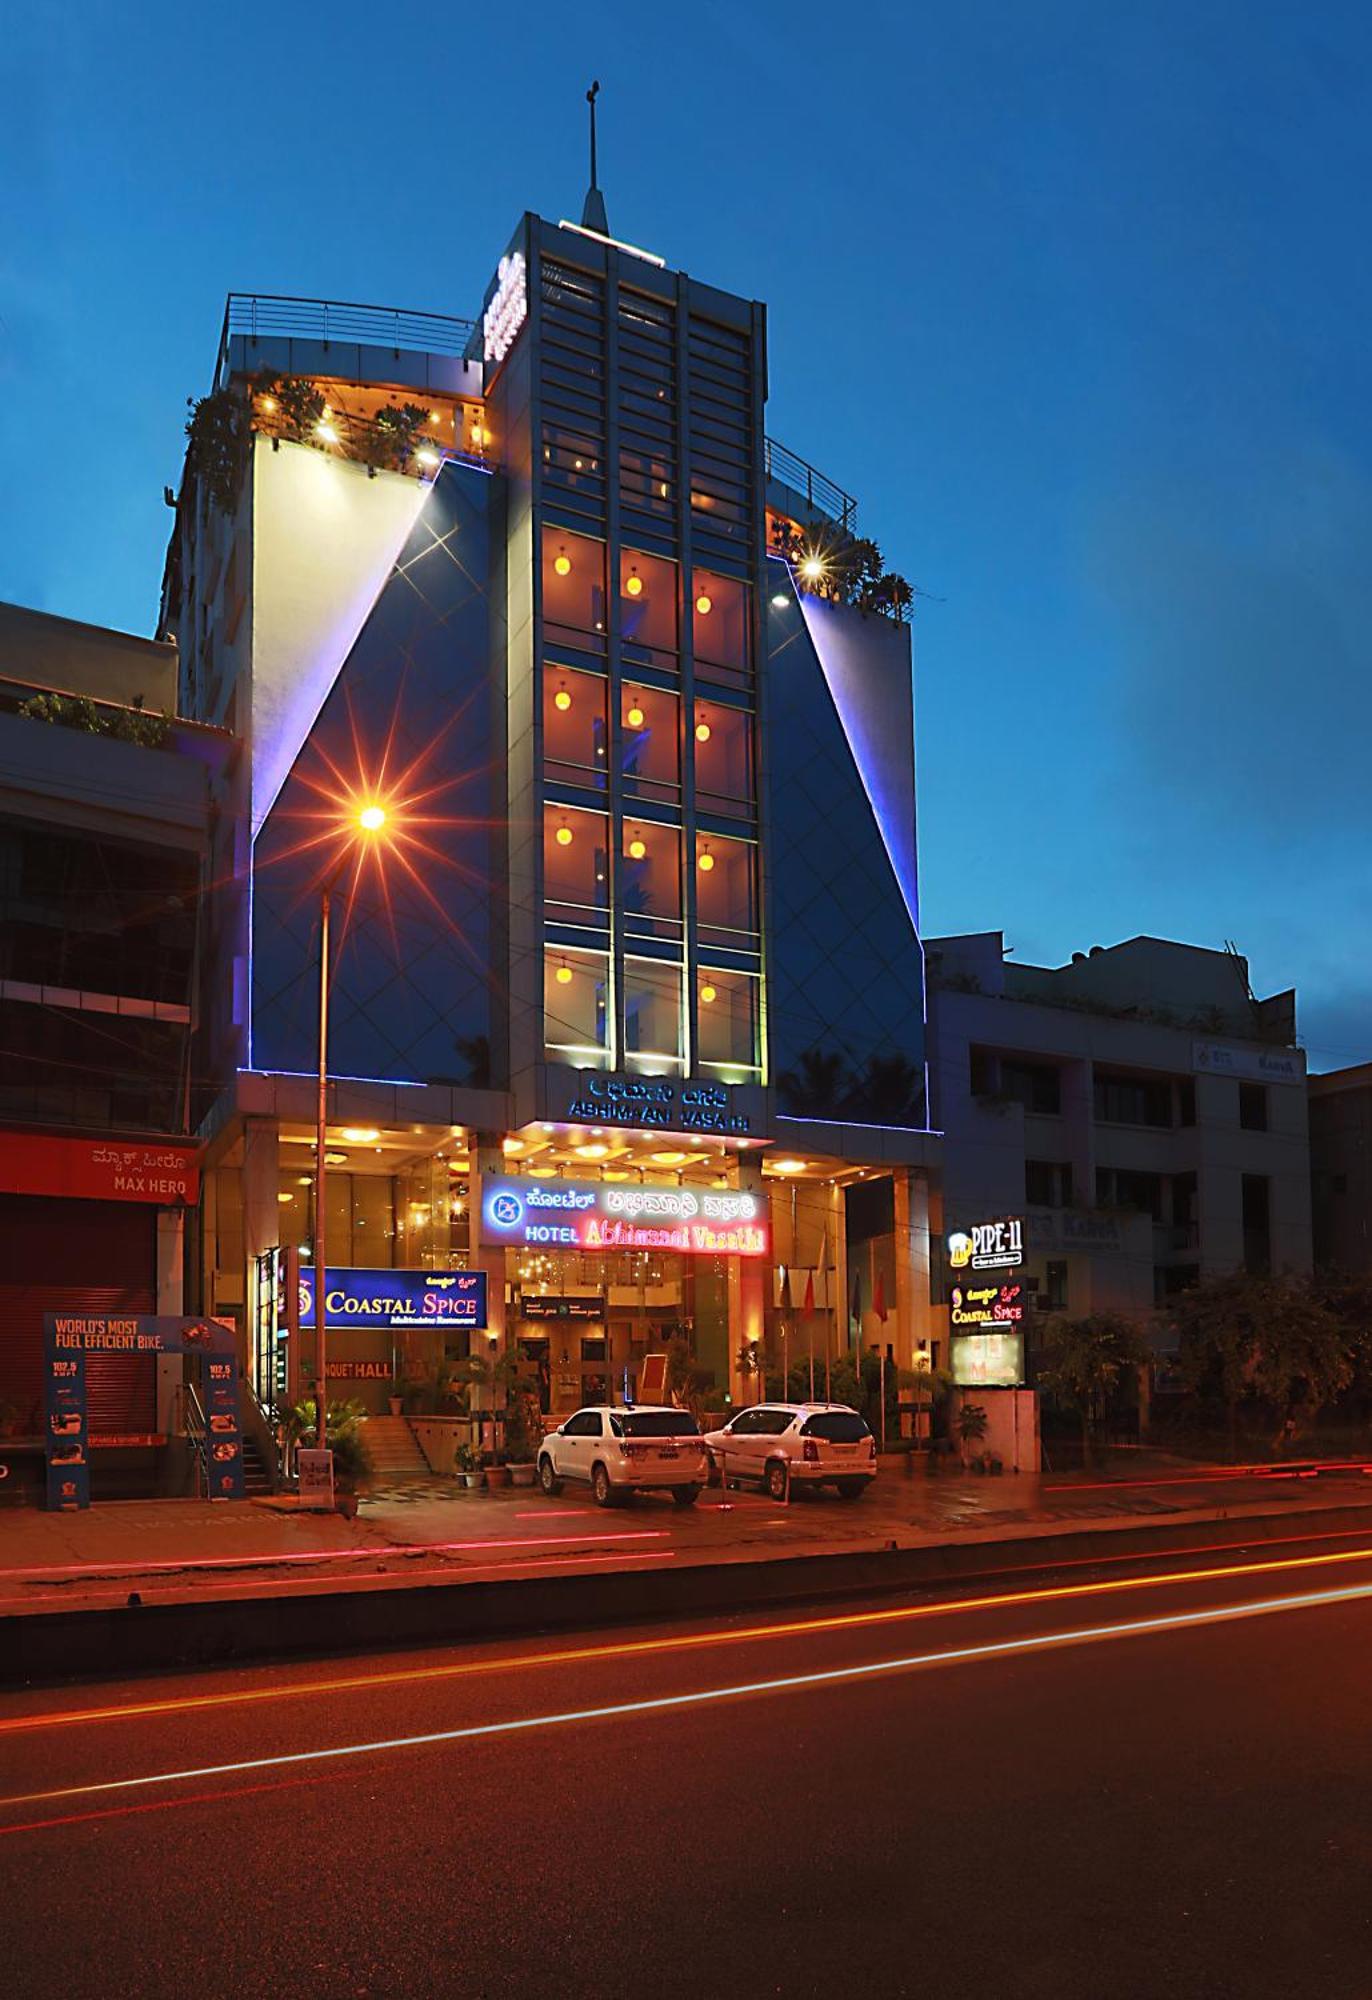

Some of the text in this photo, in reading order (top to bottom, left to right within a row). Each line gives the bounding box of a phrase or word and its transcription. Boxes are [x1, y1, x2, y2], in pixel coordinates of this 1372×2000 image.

[114, 1177, 186, 1194] MAX HERO
[526, 1188, 756, 1220] ಹೋಟೆಲ್ ಅಭಿಮಾನಿ ವಸತಿ
[525, 1226, 580, 1243] HOTEL
[692, 1225, 764, 1252] Vasathi
[56, 1319, 138, 1335] WORLD'S MOST
[56, 1335, 82, 1348] FUEL
[84, 1335, 134, 1349] EFFICIENT
[210, 1365, 231, 1375] 102.5
[355, 1363, 391, 1377] HALL
